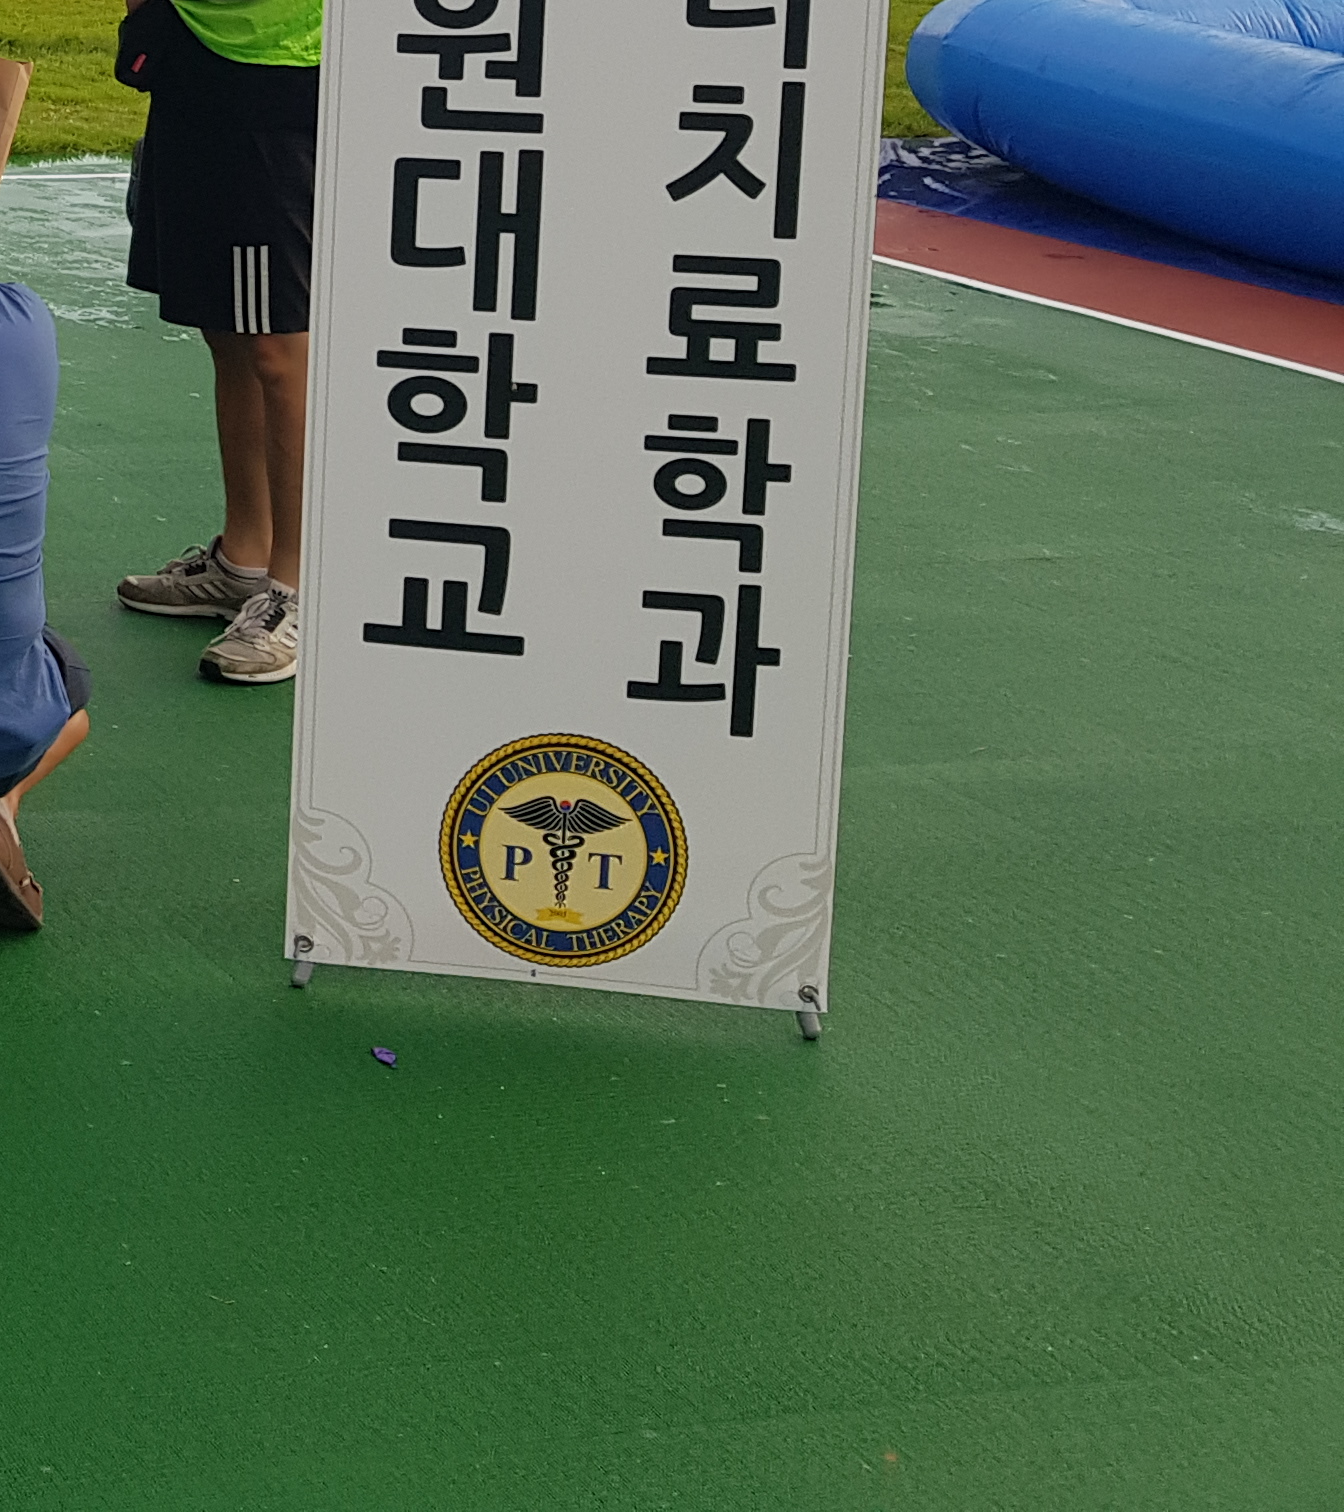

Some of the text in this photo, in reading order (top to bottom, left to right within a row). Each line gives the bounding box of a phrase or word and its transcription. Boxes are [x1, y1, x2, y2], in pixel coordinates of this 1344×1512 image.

[496, 752, 660, 815] UNIVERSITY
[500, 844, 623, 891] P T
[462, 867, 662, 951] PHYSICAL THERAPY
